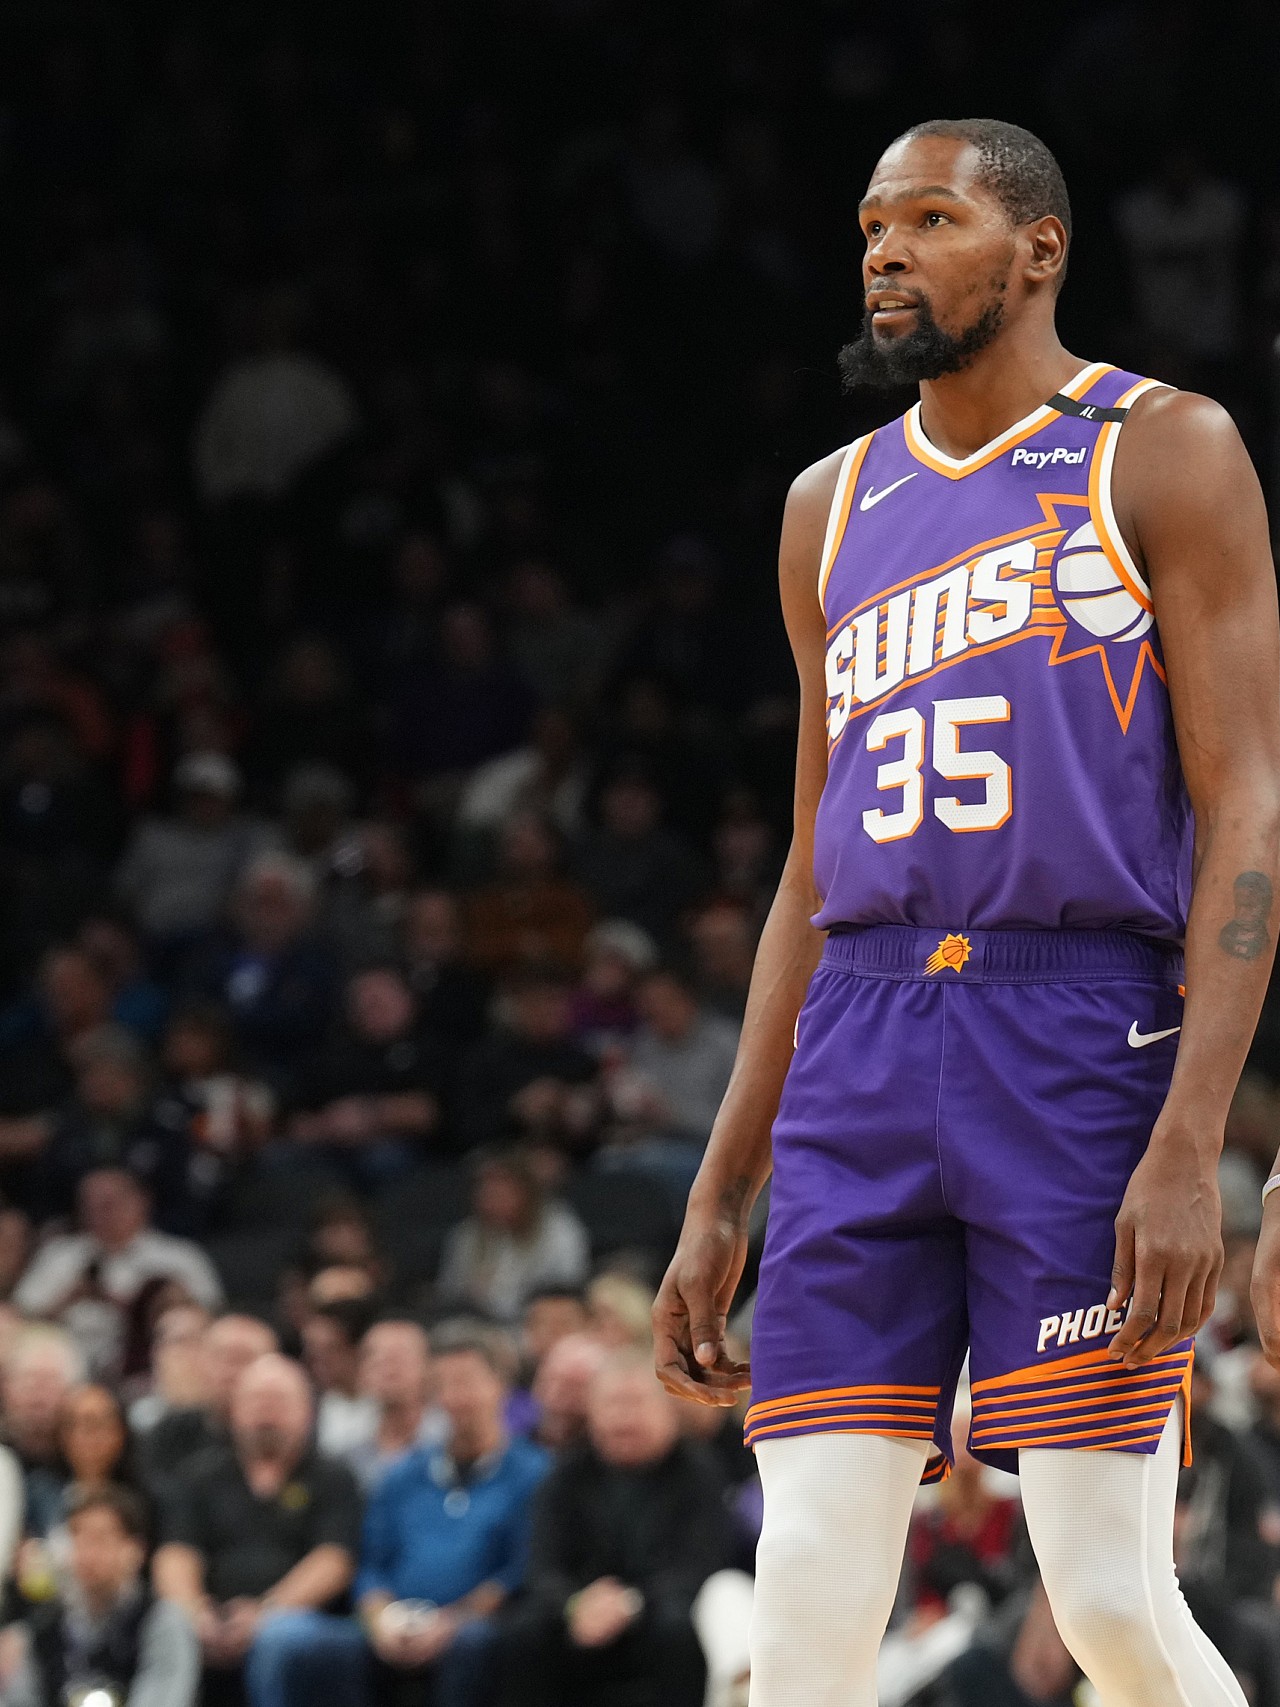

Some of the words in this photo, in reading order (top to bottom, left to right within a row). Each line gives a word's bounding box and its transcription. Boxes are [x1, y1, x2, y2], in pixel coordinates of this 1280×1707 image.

[1079, 405, 1097, 420] AL
[1011, 447, 1087, 470] PayPal
[825, 539, 1037, 740] SUNS
[862, 695, 1013, 844] 35
[1036, 1296, 1135, 1354] PHOE
